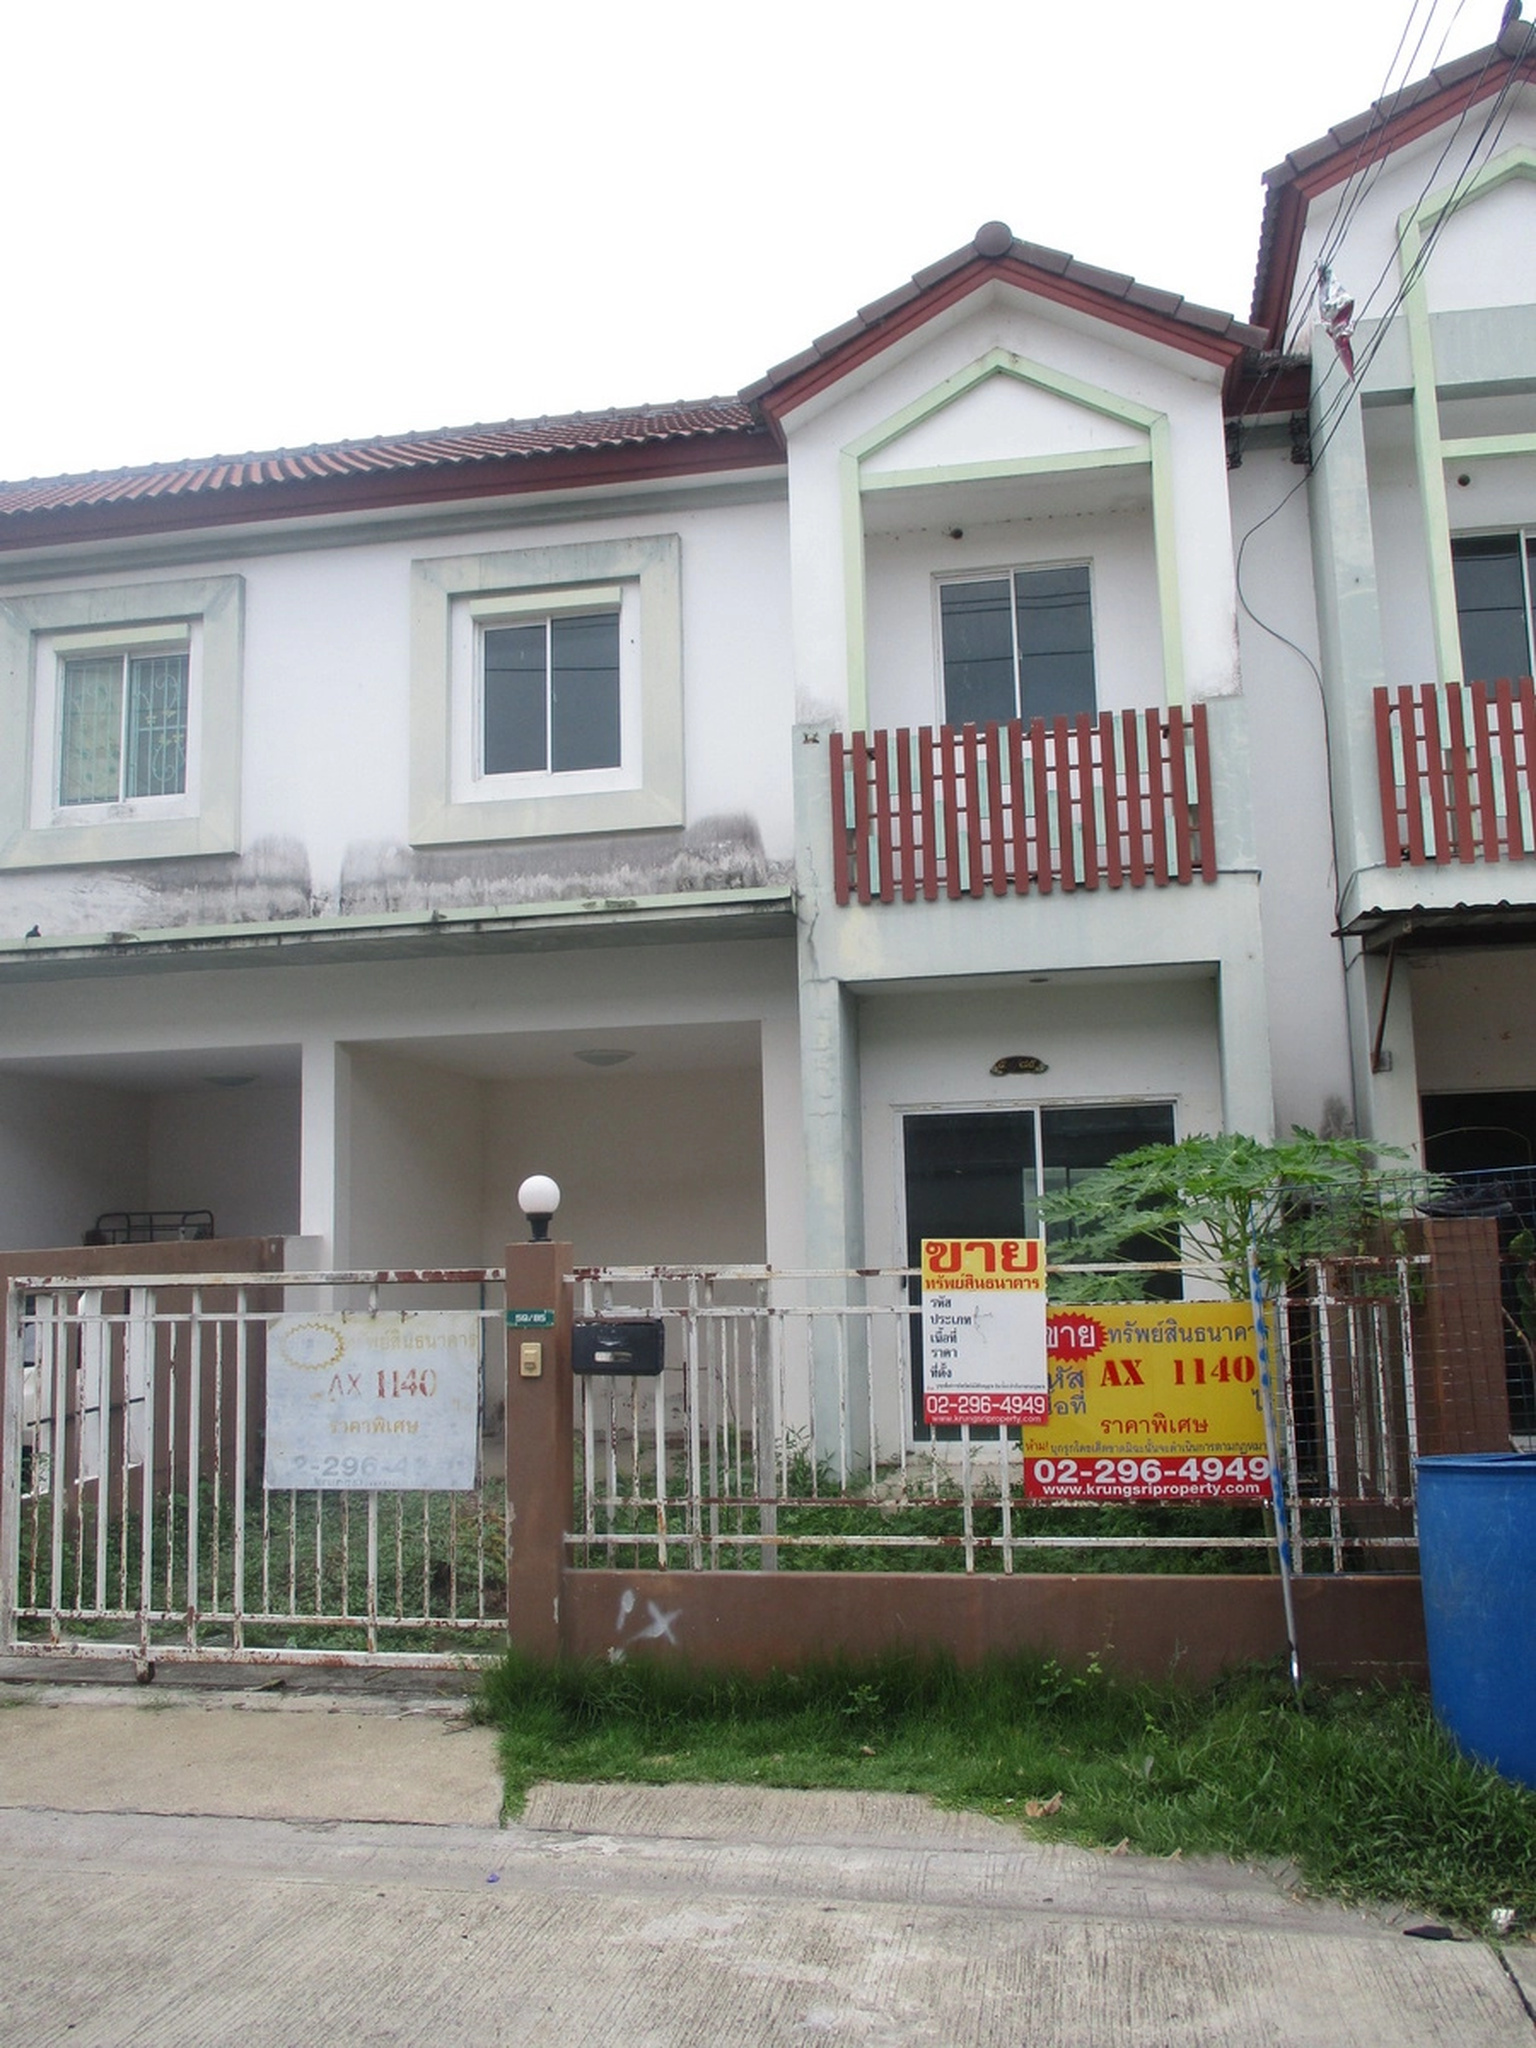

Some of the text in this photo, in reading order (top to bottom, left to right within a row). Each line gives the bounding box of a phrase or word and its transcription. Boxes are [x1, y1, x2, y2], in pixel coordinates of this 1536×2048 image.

[925, 1241, 1038, 1273] ขาย
[925, 1273, 1040, 1290] ทรัพย์สินธนาคาร
[930, 1295, 952, 1308] รหัส
[930, 1314, 972, 1325] ประเภท
[1107, 1317, 1269, 1344] ทรัพย์สินธนาค
[931, 1348, 958, 1358] ราคา
[1101, 1359, 1144, 1387] AX
[1173, 1355, 1255, 1386] 1140
[377, 1368, 437, 1398] 1140
[926, 1395, 1045, 1414] 02-296-4949
[1101, 1412, 1209, 1434] ราคาพิเศษ
[1034, 1457, 1270, 1484] 02-296-4949
[1042, 1483, 1260, 1497] www.krungsriproperty.com
